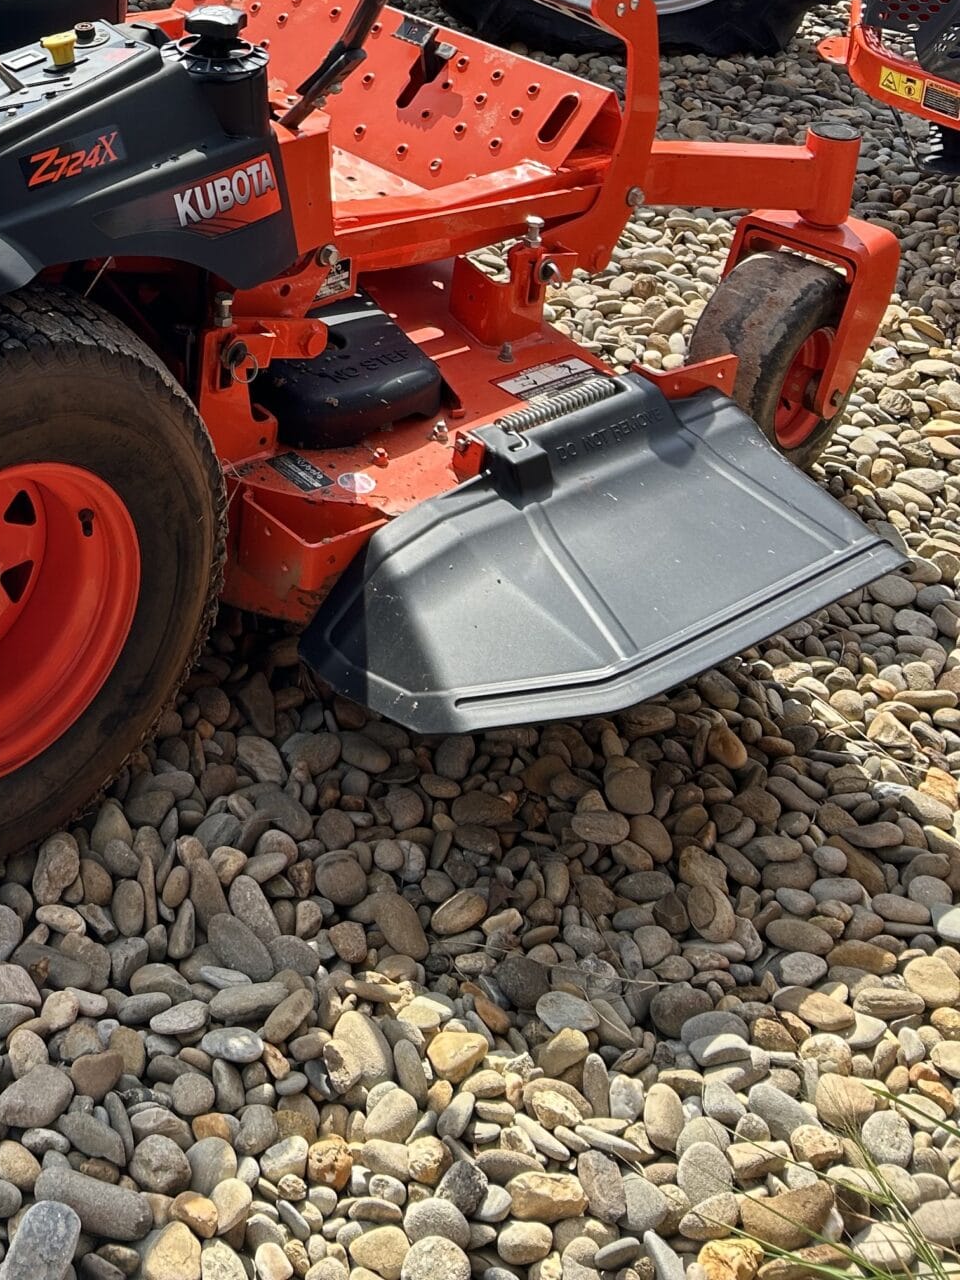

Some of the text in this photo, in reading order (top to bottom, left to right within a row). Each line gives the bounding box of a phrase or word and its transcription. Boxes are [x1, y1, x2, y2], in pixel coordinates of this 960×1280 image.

[28, 131, 118, 187] Z724X
[173, 160, 276, 228] KUBOTA
[328, 349, 409, 383] NO STEP
[555, 407, 665, 461] DO NOT REMOVE
